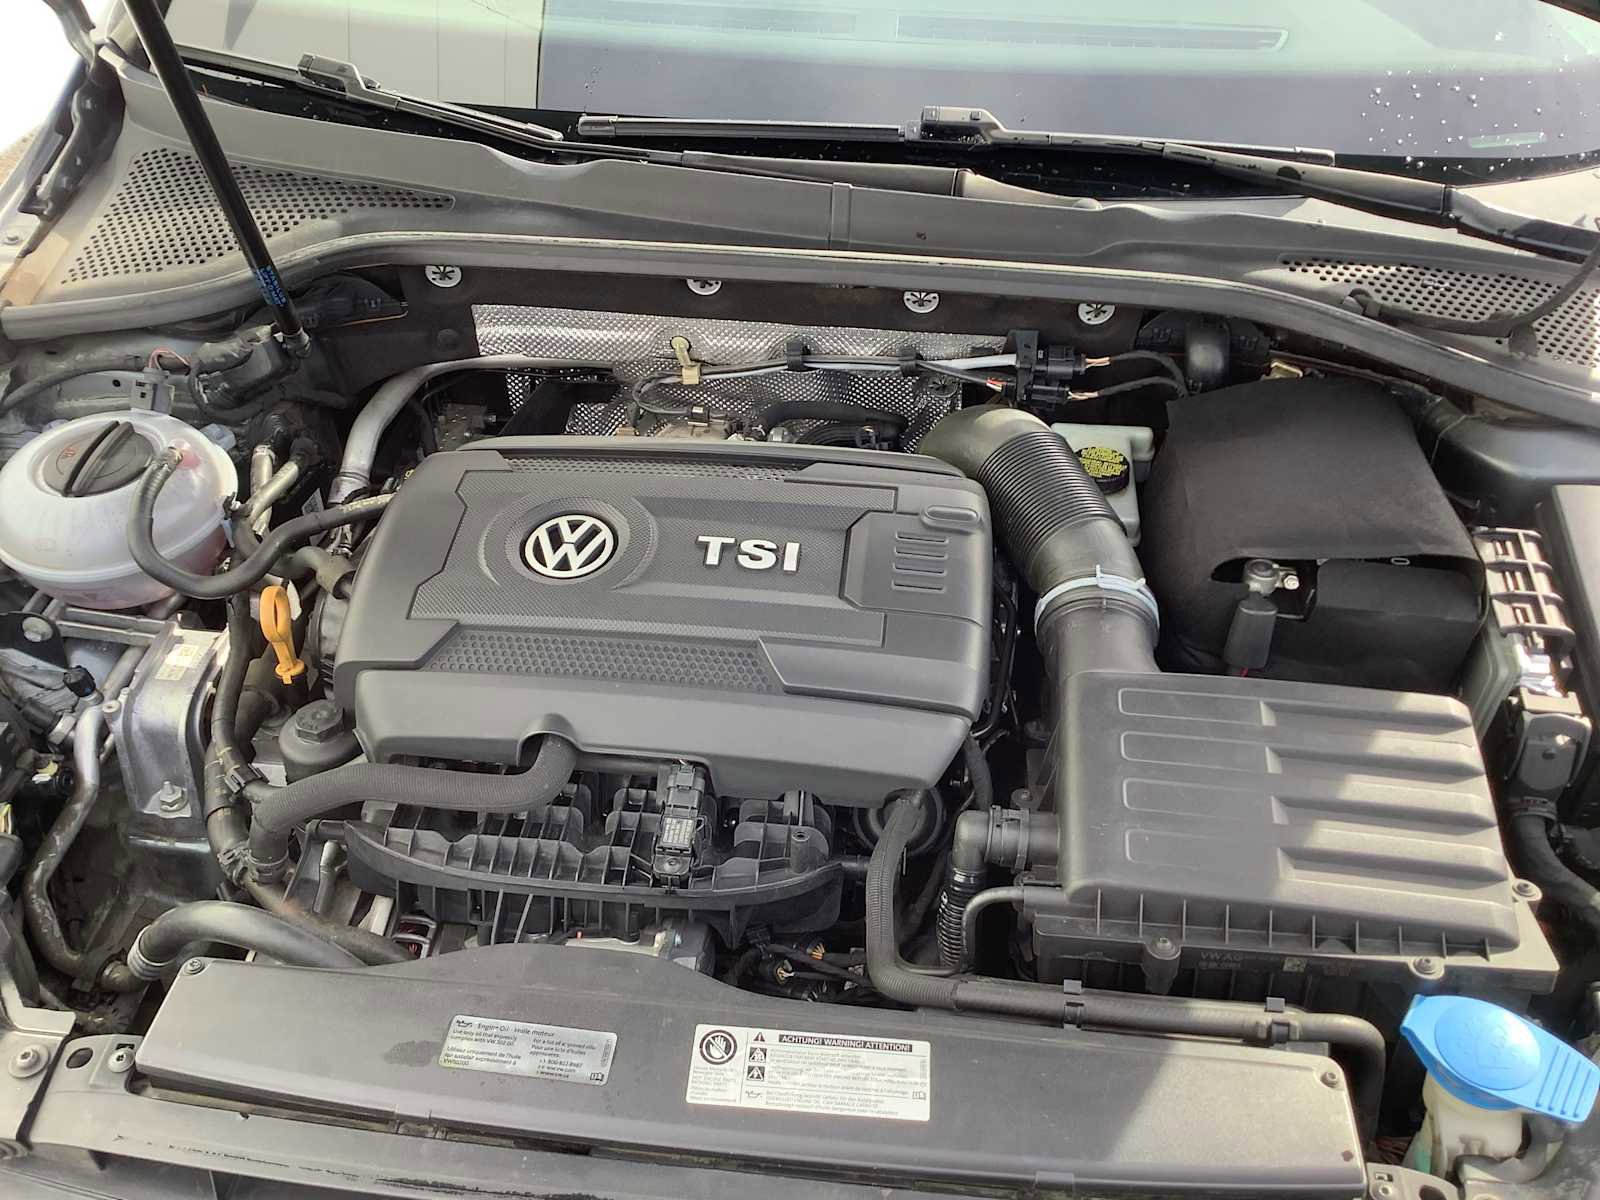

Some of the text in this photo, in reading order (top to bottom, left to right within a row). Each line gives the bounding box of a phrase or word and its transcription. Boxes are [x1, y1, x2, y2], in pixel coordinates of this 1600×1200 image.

[523, 513, 615, 579] VW
[696, 534, 801, 573] TSI
[781, 1035, 911, 1052] ACHTUNG! WARNING! ATTENTION!
